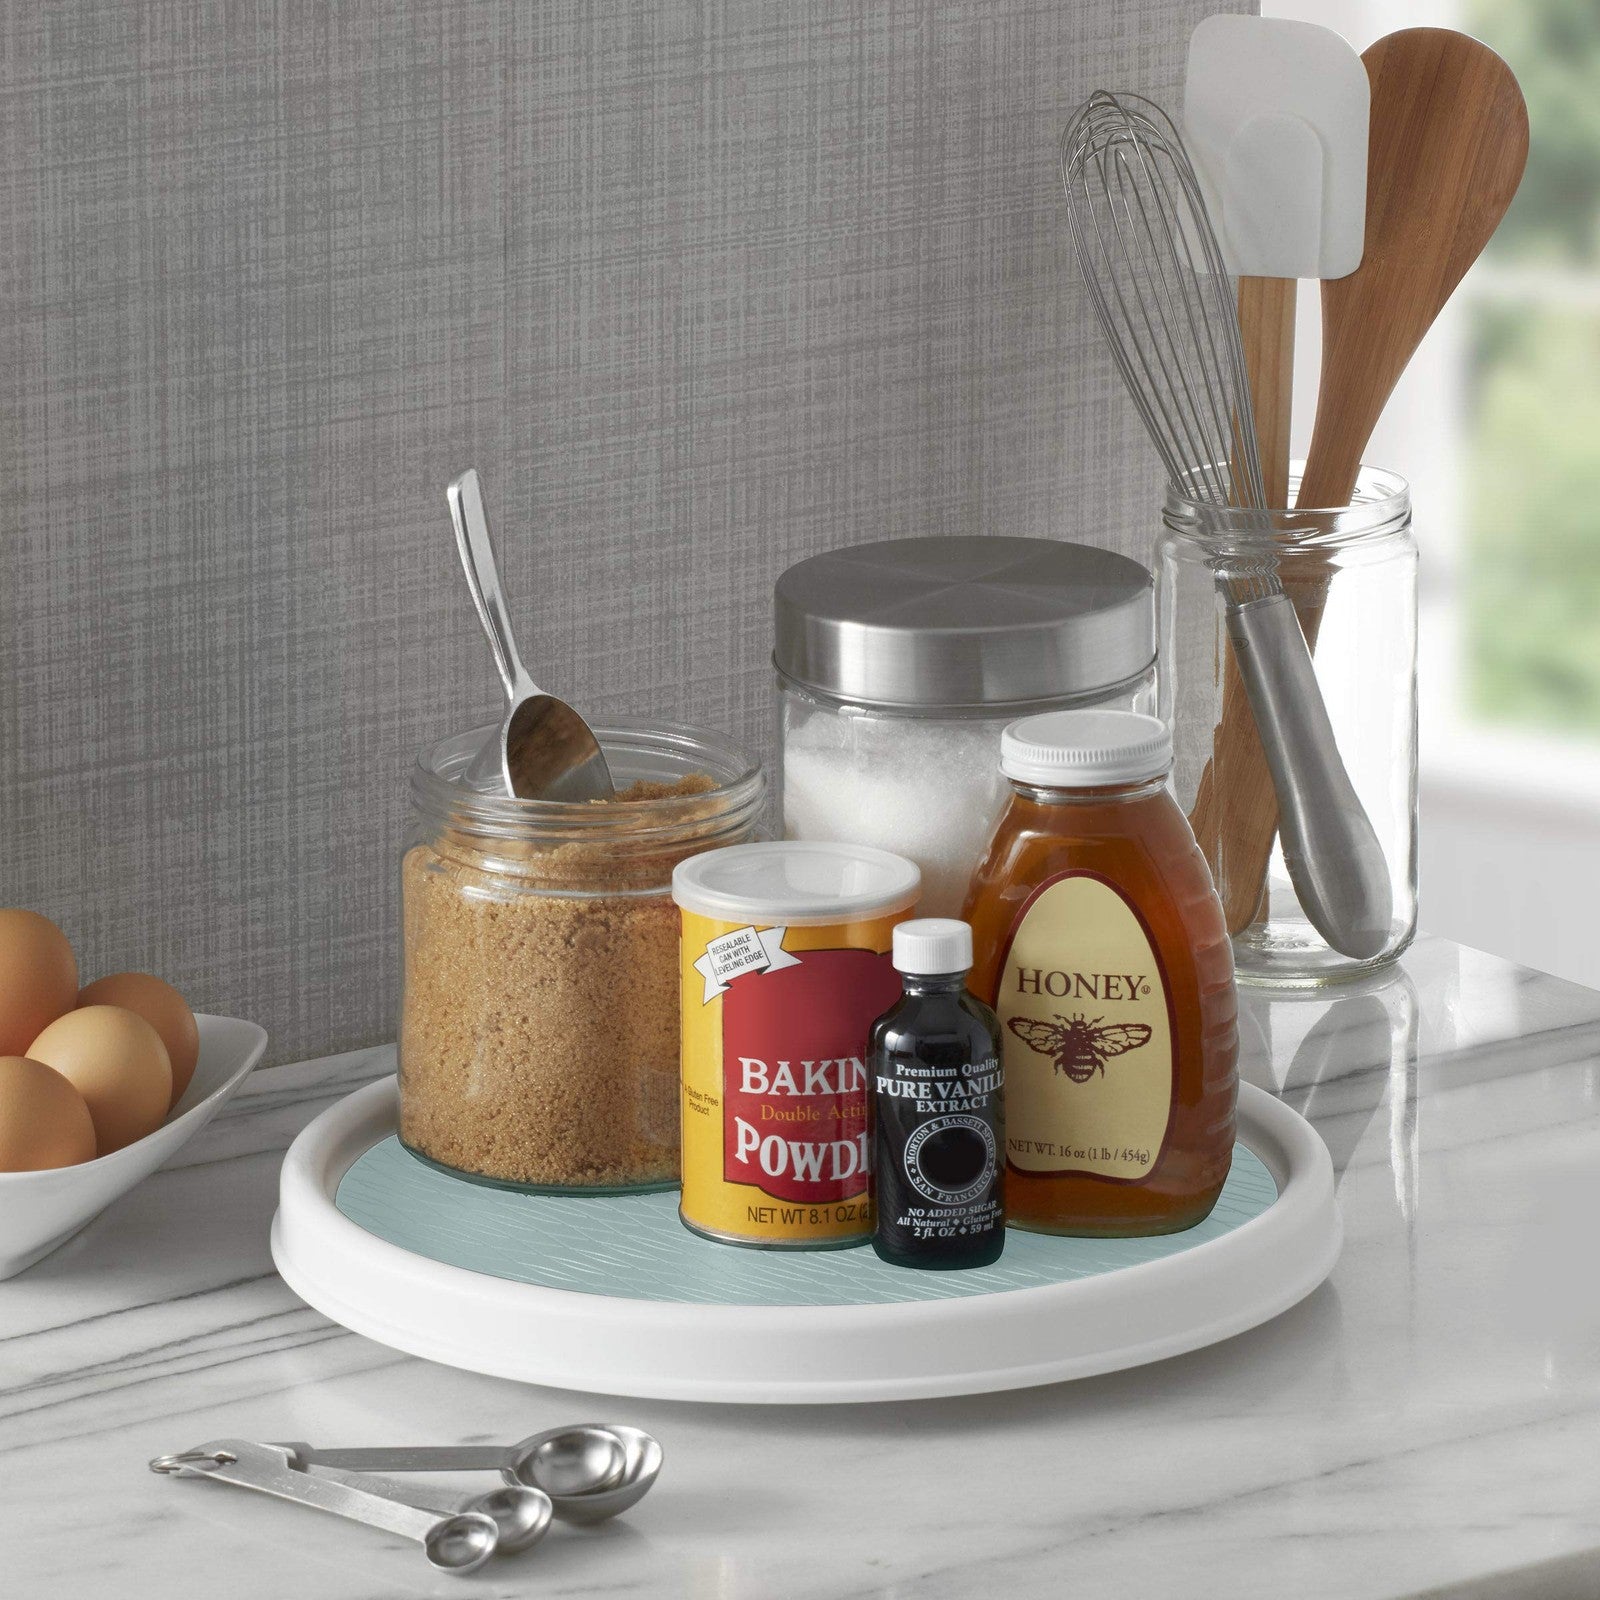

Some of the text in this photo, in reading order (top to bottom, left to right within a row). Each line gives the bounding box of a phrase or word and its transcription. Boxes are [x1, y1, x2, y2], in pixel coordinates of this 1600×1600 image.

[711, 934, 751, 956] RESEALABLE
[719, 945, 750, 964] CAN WITH
[714, 950, 764, 976] LEVELING EDGE
[1016, 966, 1147, 1001] HONEY
[896, 1058, 999, 1078] Premium Quality
[876, 1067, 1005, 1099] PURE VANILL
[688, 1085, 703, 1102] Gluten
[704, 1093, 719, 1107] Free
[916, 1095, 989, 1113] EXTRACT
[689, 1098, 710, 1117] Product
[761, 1104, 821, 1121] Double
[907, 1127, 930, 1165] MORTON
[931, 1122, 940, 1131] &
[942, 1117, 984, 1130] BASSETT
[1009, 1138, 1033, 1153] NET
[1035, 1142, 1056, 1156] WT.
[1060, 1145, 1072, 1158] 16
[1074, 1150, 1086, 1159] oz
[1088, 1146, 1098, 1161] (1
[1101, 1147, 1111, 1160] lb
[1121, 1148, 1151, 1165] 454g)
[913, 1171, 991, 1202] SAN FRANCISCO
[747, 1206, 777, 1223] NET
[781, 1208, 807, 1224] WT
[809, 1208, 830, 1225] 8.1
[835, 1205, 857, 1222] OZ
[907, 1200, 997, 1218] NO ADDED SUGAR
[896, 1217, 911, 1226] All
[912, 1218, 950, 1227] Natural
[963, 1213, 990, 1225] Gluten
[914, 1220, 994, 1240] 2 fl. OZ 59 ml
